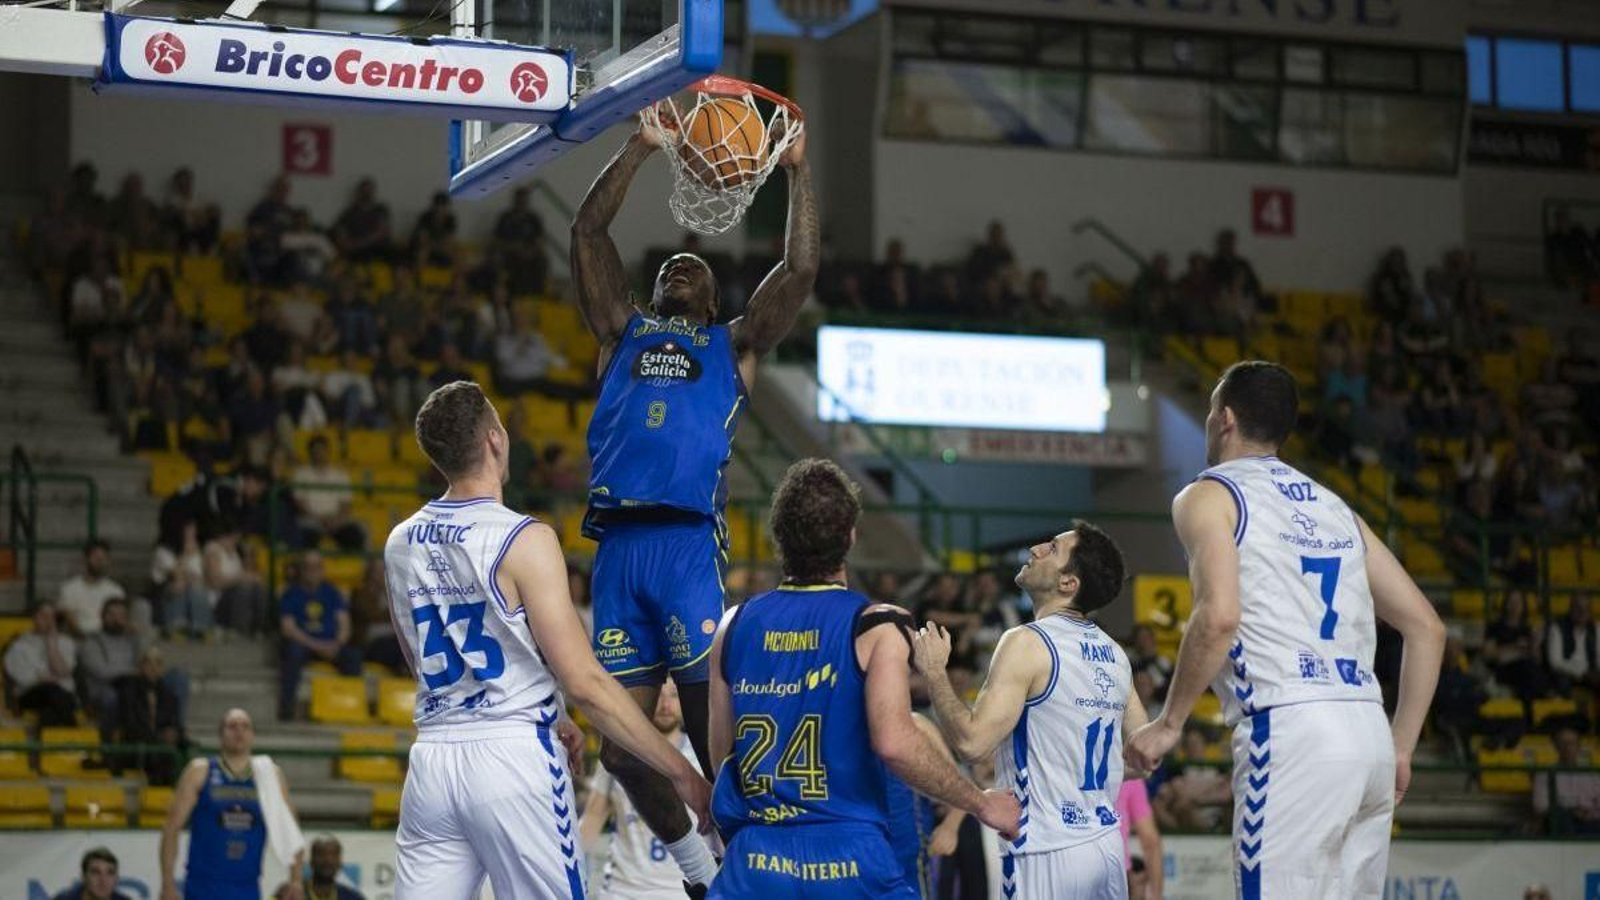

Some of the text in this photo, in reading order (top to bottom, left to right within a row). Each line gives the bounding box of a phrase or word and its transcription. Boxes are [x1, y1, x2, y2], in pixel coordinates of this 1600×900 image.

[214, 38, 485, 94] BricoCentro
[293, 129, 320, 169] 3
[1260, 193, 1283, 229] 4
[640, 351, 691, 369] Estrella
[640, 363, 687, 378] Galicia
[646, 400, 667, 428] 9
[1300, 555, 1342, 640] 7
[411, 601, 506, 691] 33
[1080, 642, 1116, 663] MANU
[732, 677, 801, 697] cloud.gal
[736, 714, 829, 800] 24
[1079, 716, 1116, 792] 11
